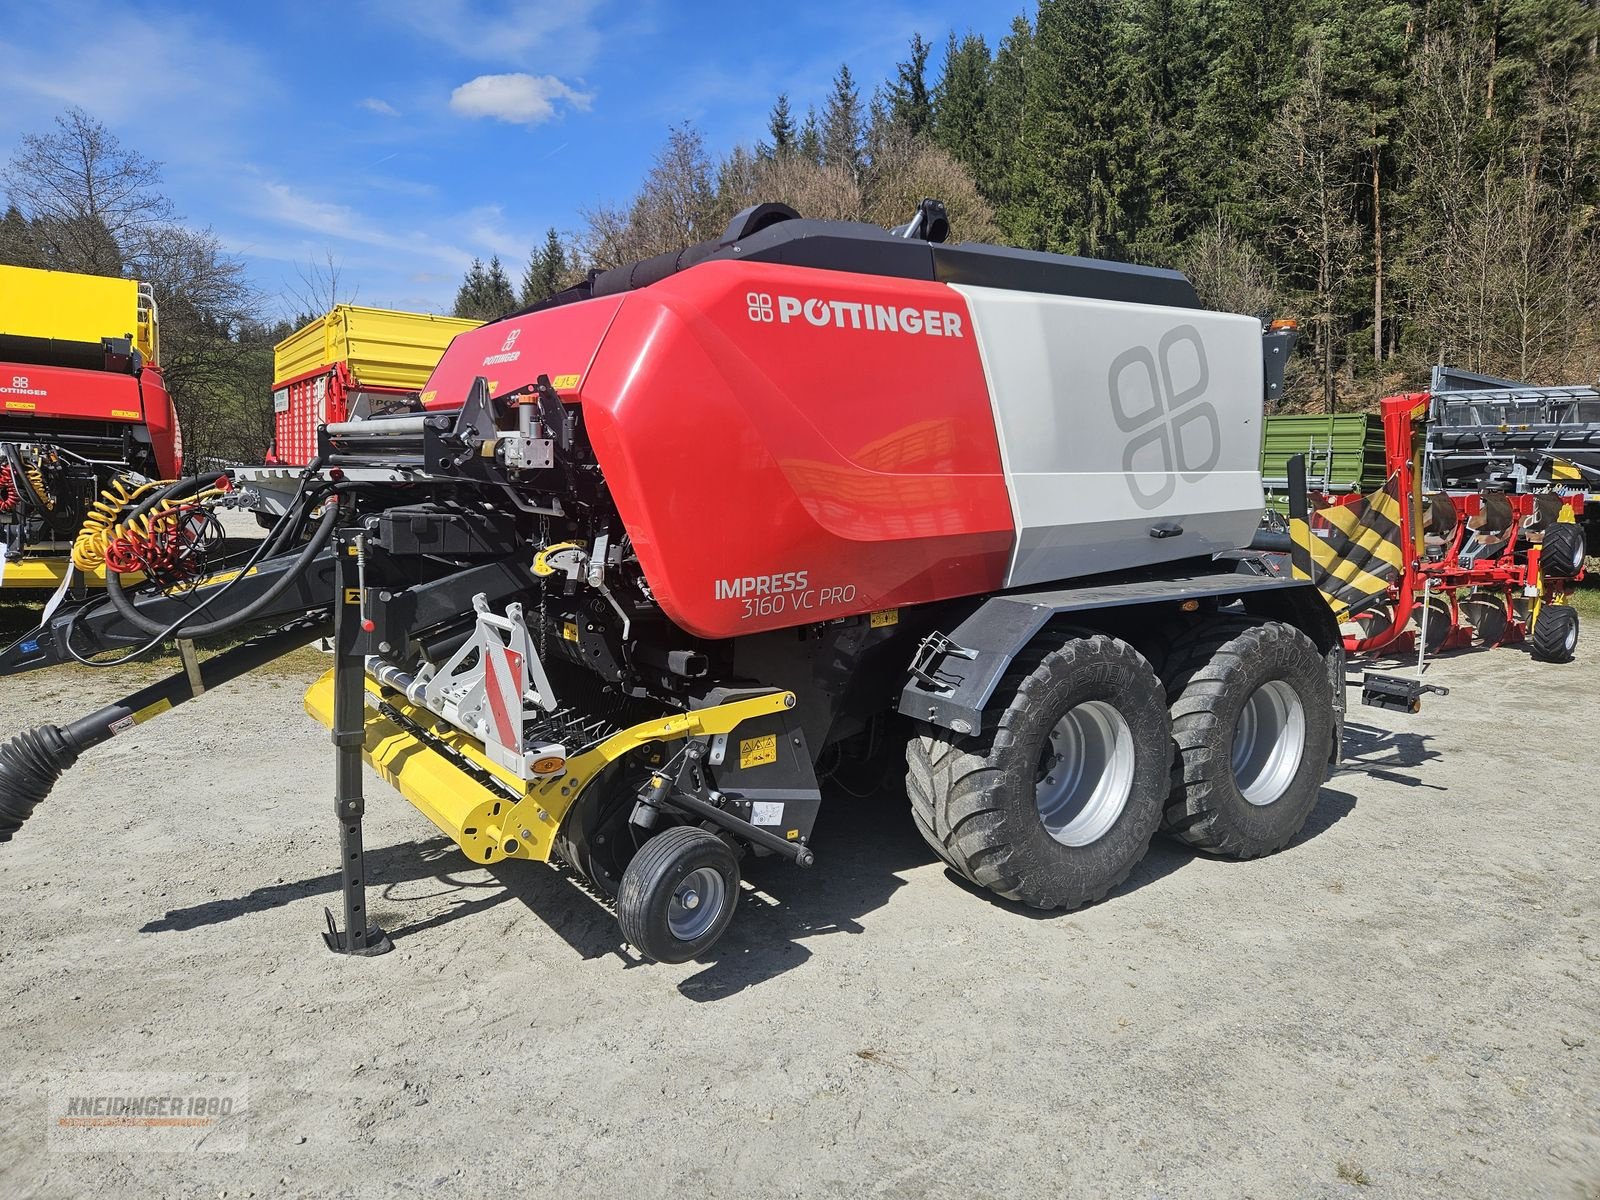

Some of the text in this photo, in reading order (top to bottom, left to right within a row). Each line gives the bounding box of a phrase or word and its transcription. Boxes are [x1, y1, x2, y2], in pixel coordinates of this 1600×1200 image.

[715, 570, 808, 600] IMPRESS
[741, 584, 856, 619] 3160 VC PRO
